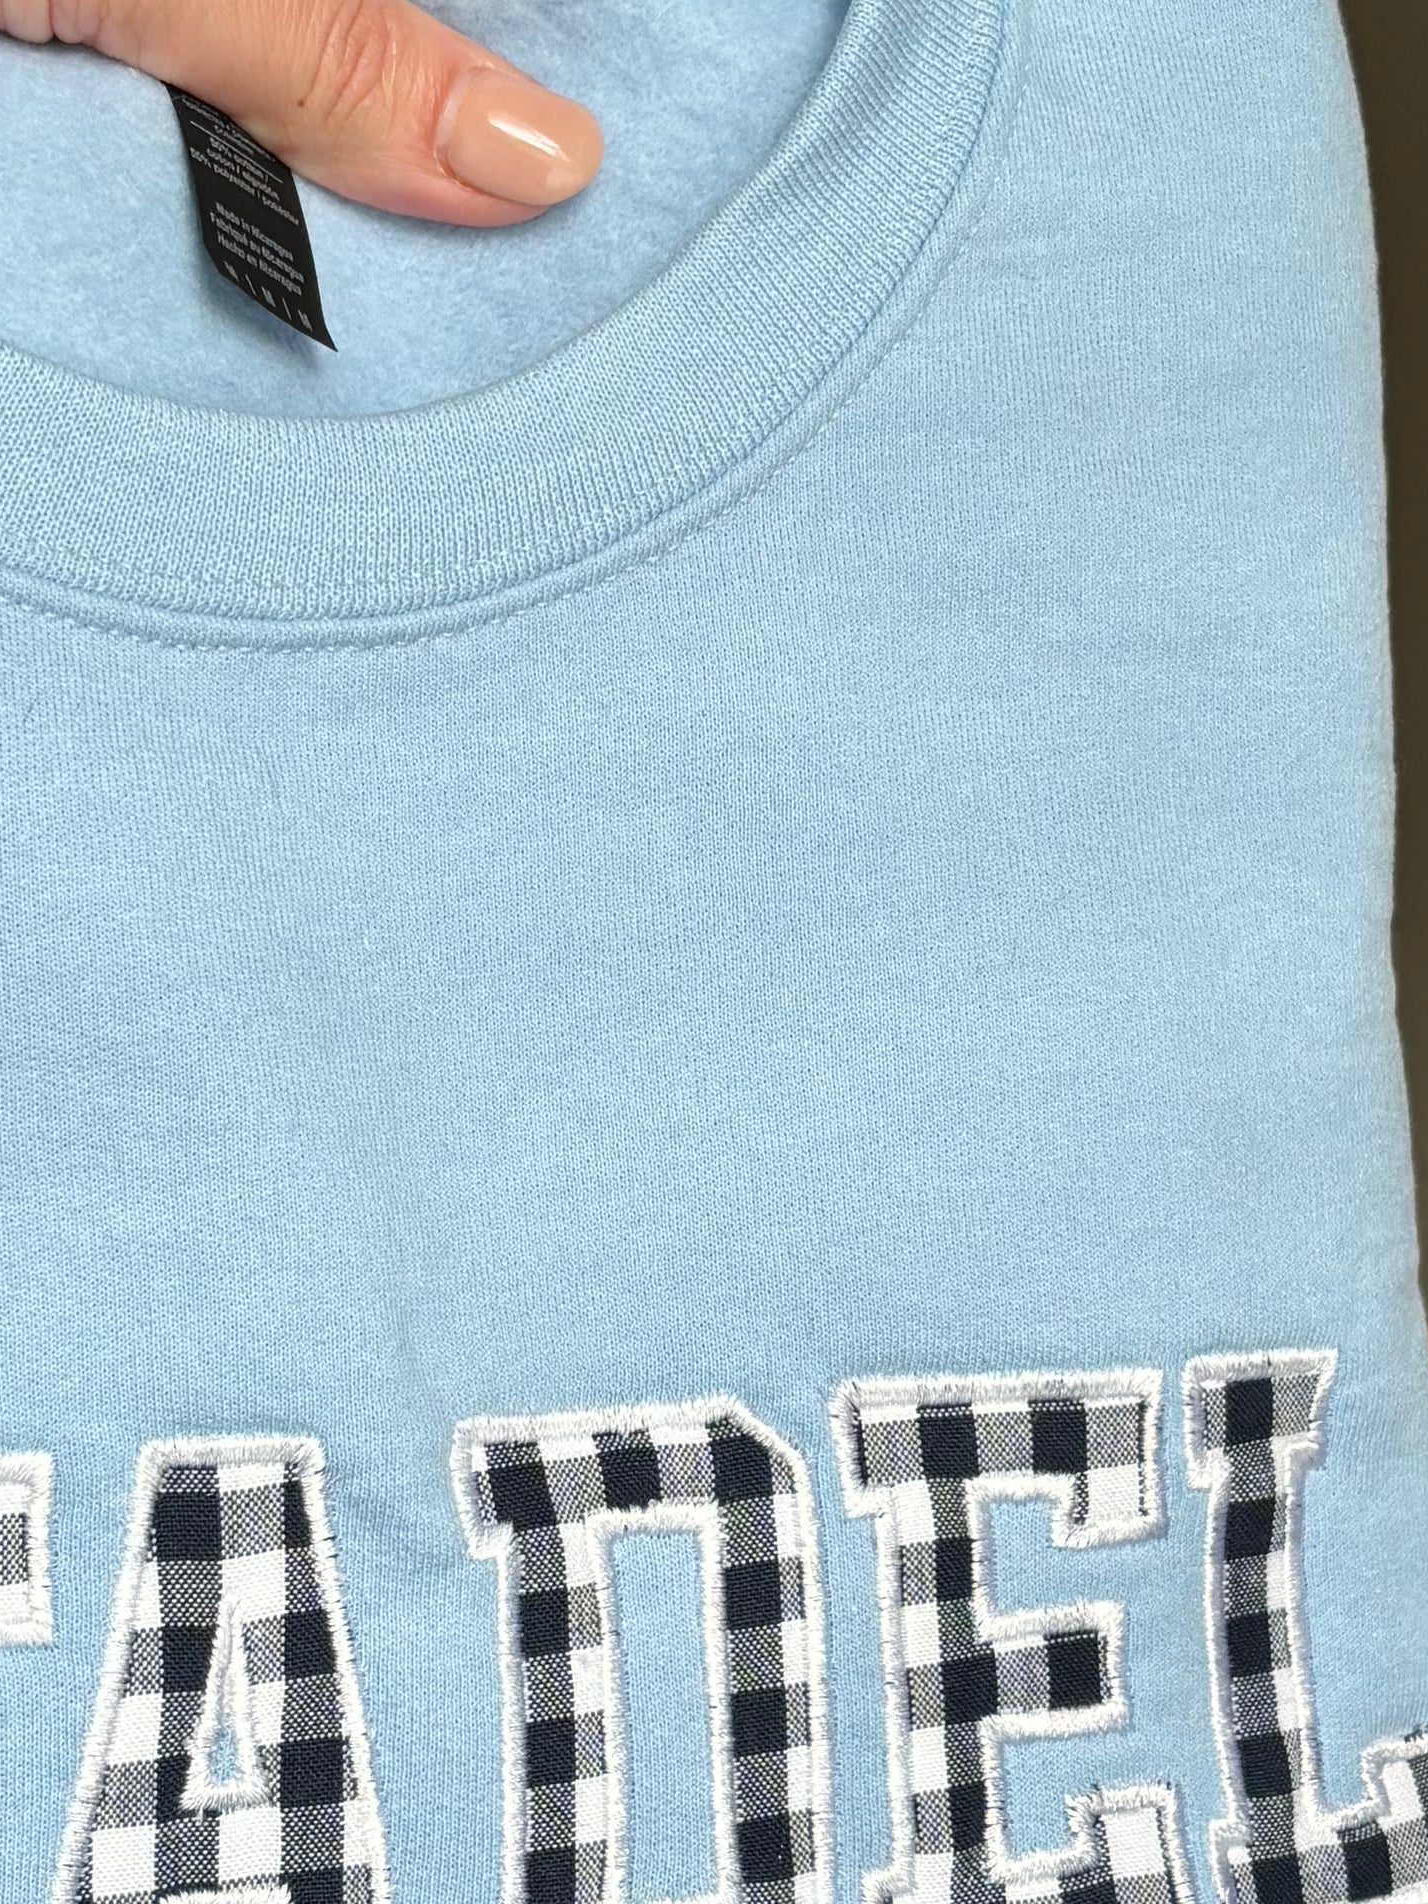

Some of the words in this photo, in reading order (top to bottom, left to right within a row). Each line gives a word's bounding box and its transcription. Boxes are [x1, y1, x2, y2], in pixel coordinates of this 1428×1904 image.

[251, 225, 294, 262] Nicaragua
[259, 258, 303, 296] Nicaragua
[261, 245, 305, 284] Nicaragua
